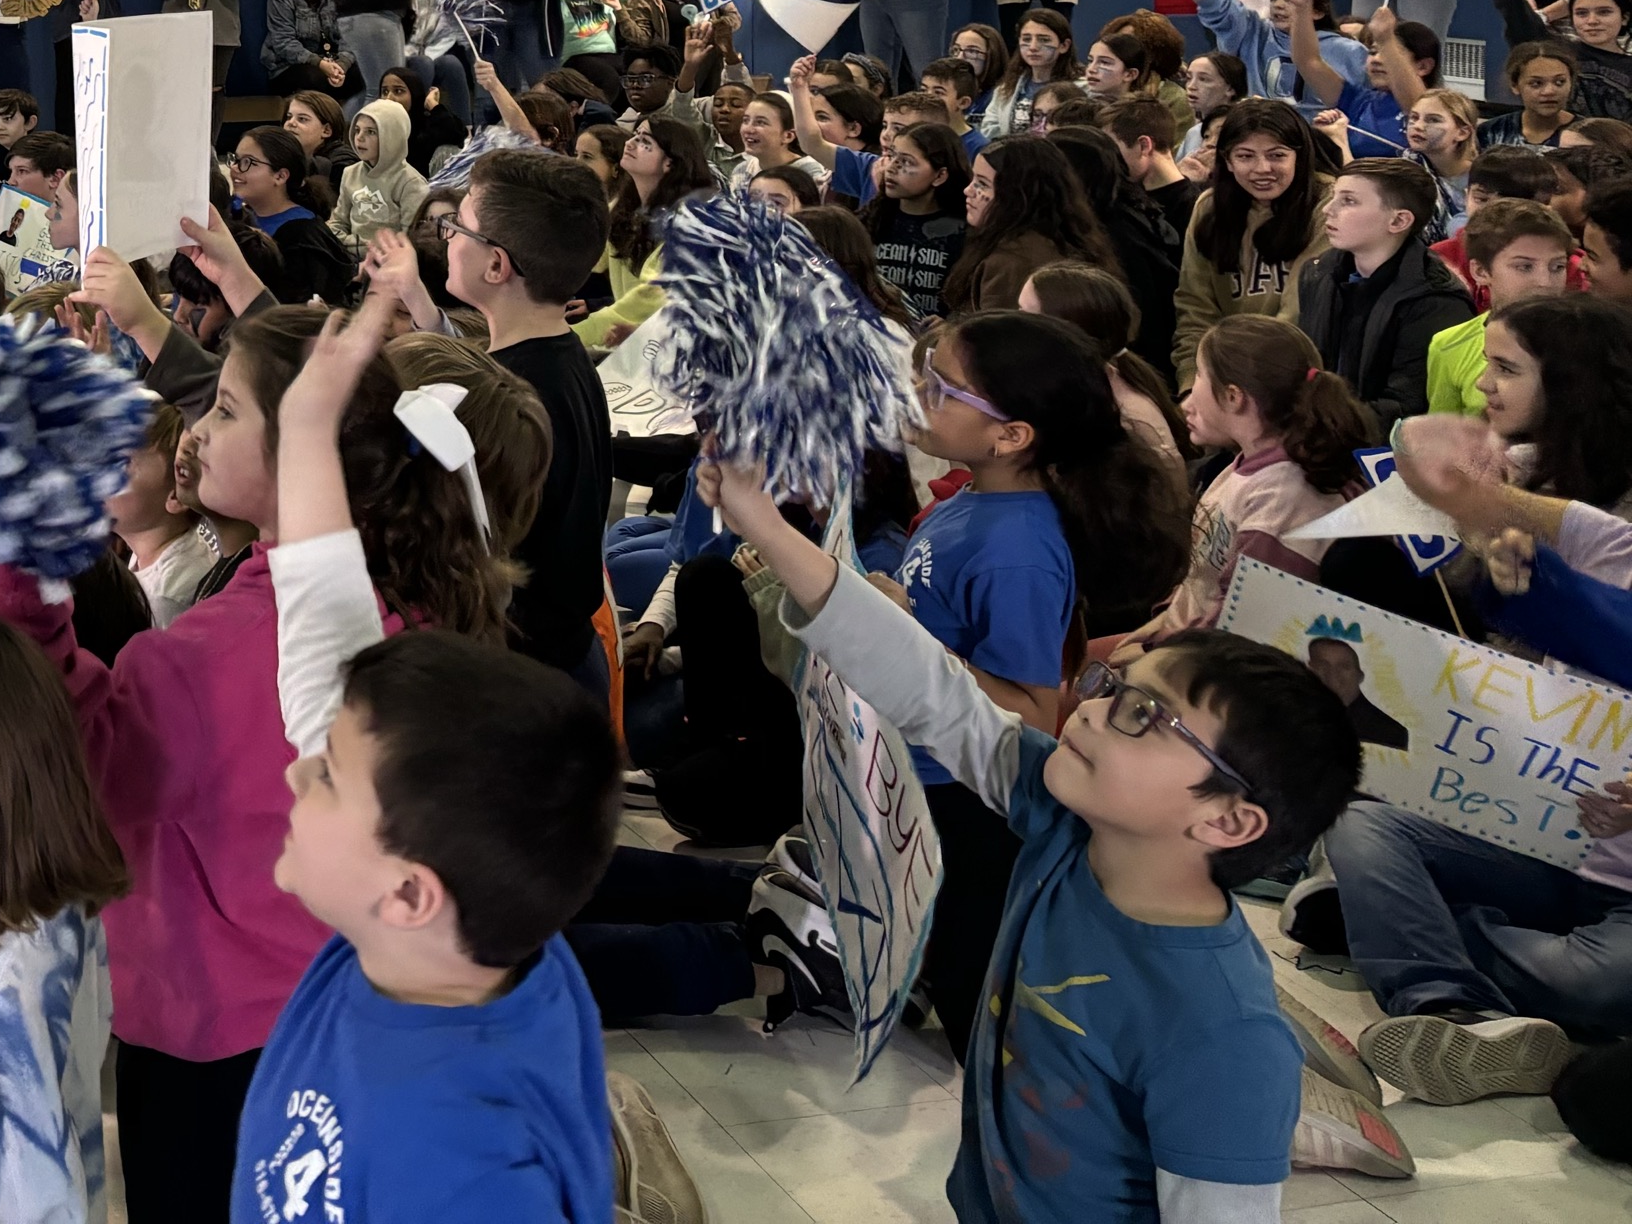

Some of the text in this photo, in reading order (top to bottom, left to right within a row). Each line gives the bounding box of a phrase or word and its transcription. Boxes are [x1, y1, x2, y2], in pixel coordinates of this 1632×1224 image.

[875, 243, 949, 268] CEAN SIDE
[875, 265, 944, 289] EAN SIDE
[1432, 648, 1632, 752] KEVIN
[1434, 709, 1500, 764] IS
